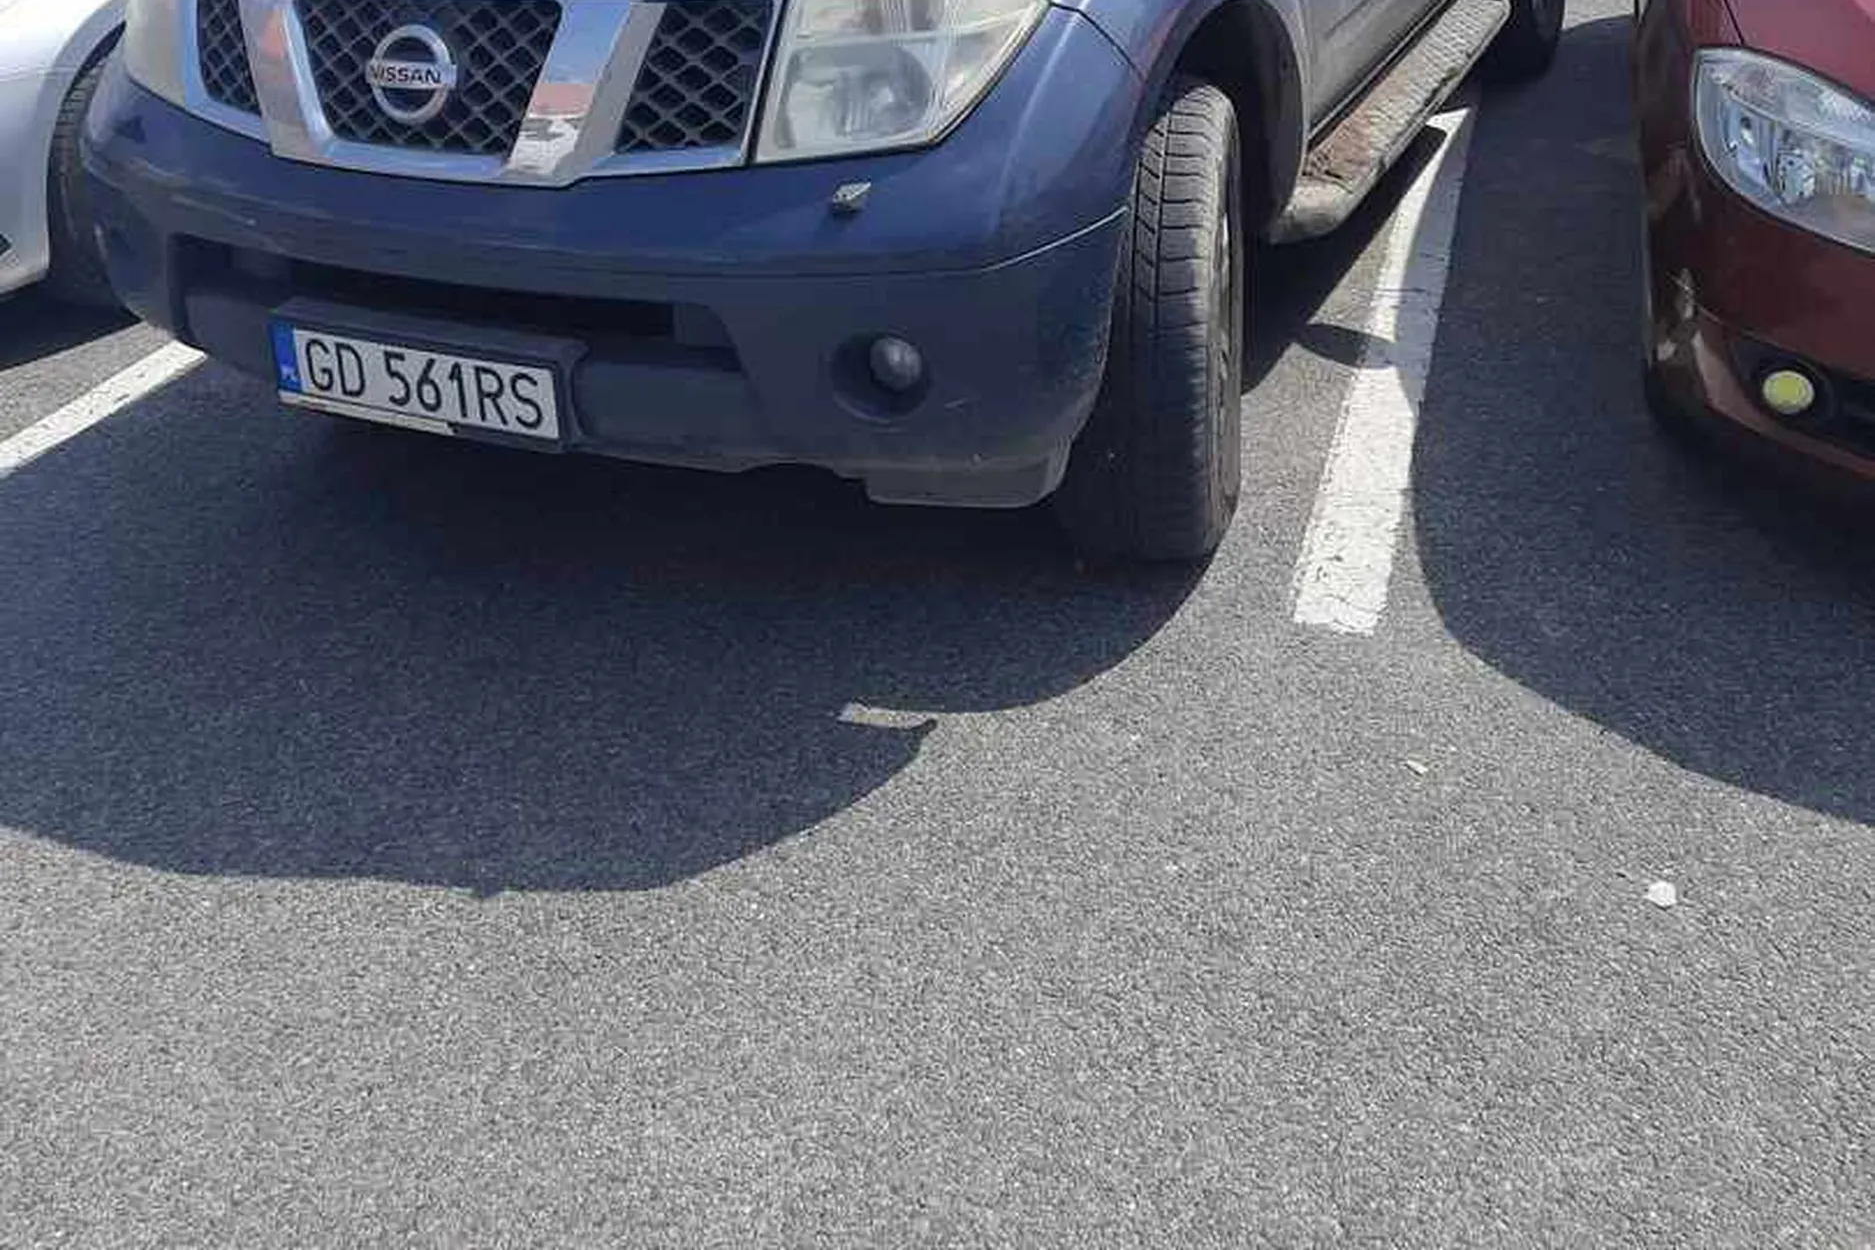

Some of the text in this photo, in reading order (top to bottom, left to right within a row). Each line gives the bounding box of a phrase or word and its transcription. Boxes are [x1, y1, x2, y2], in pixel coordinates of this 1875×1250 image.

[369, 64, 442, 84] NISSAN
[305, 338, 544, 430] GD 561RS
